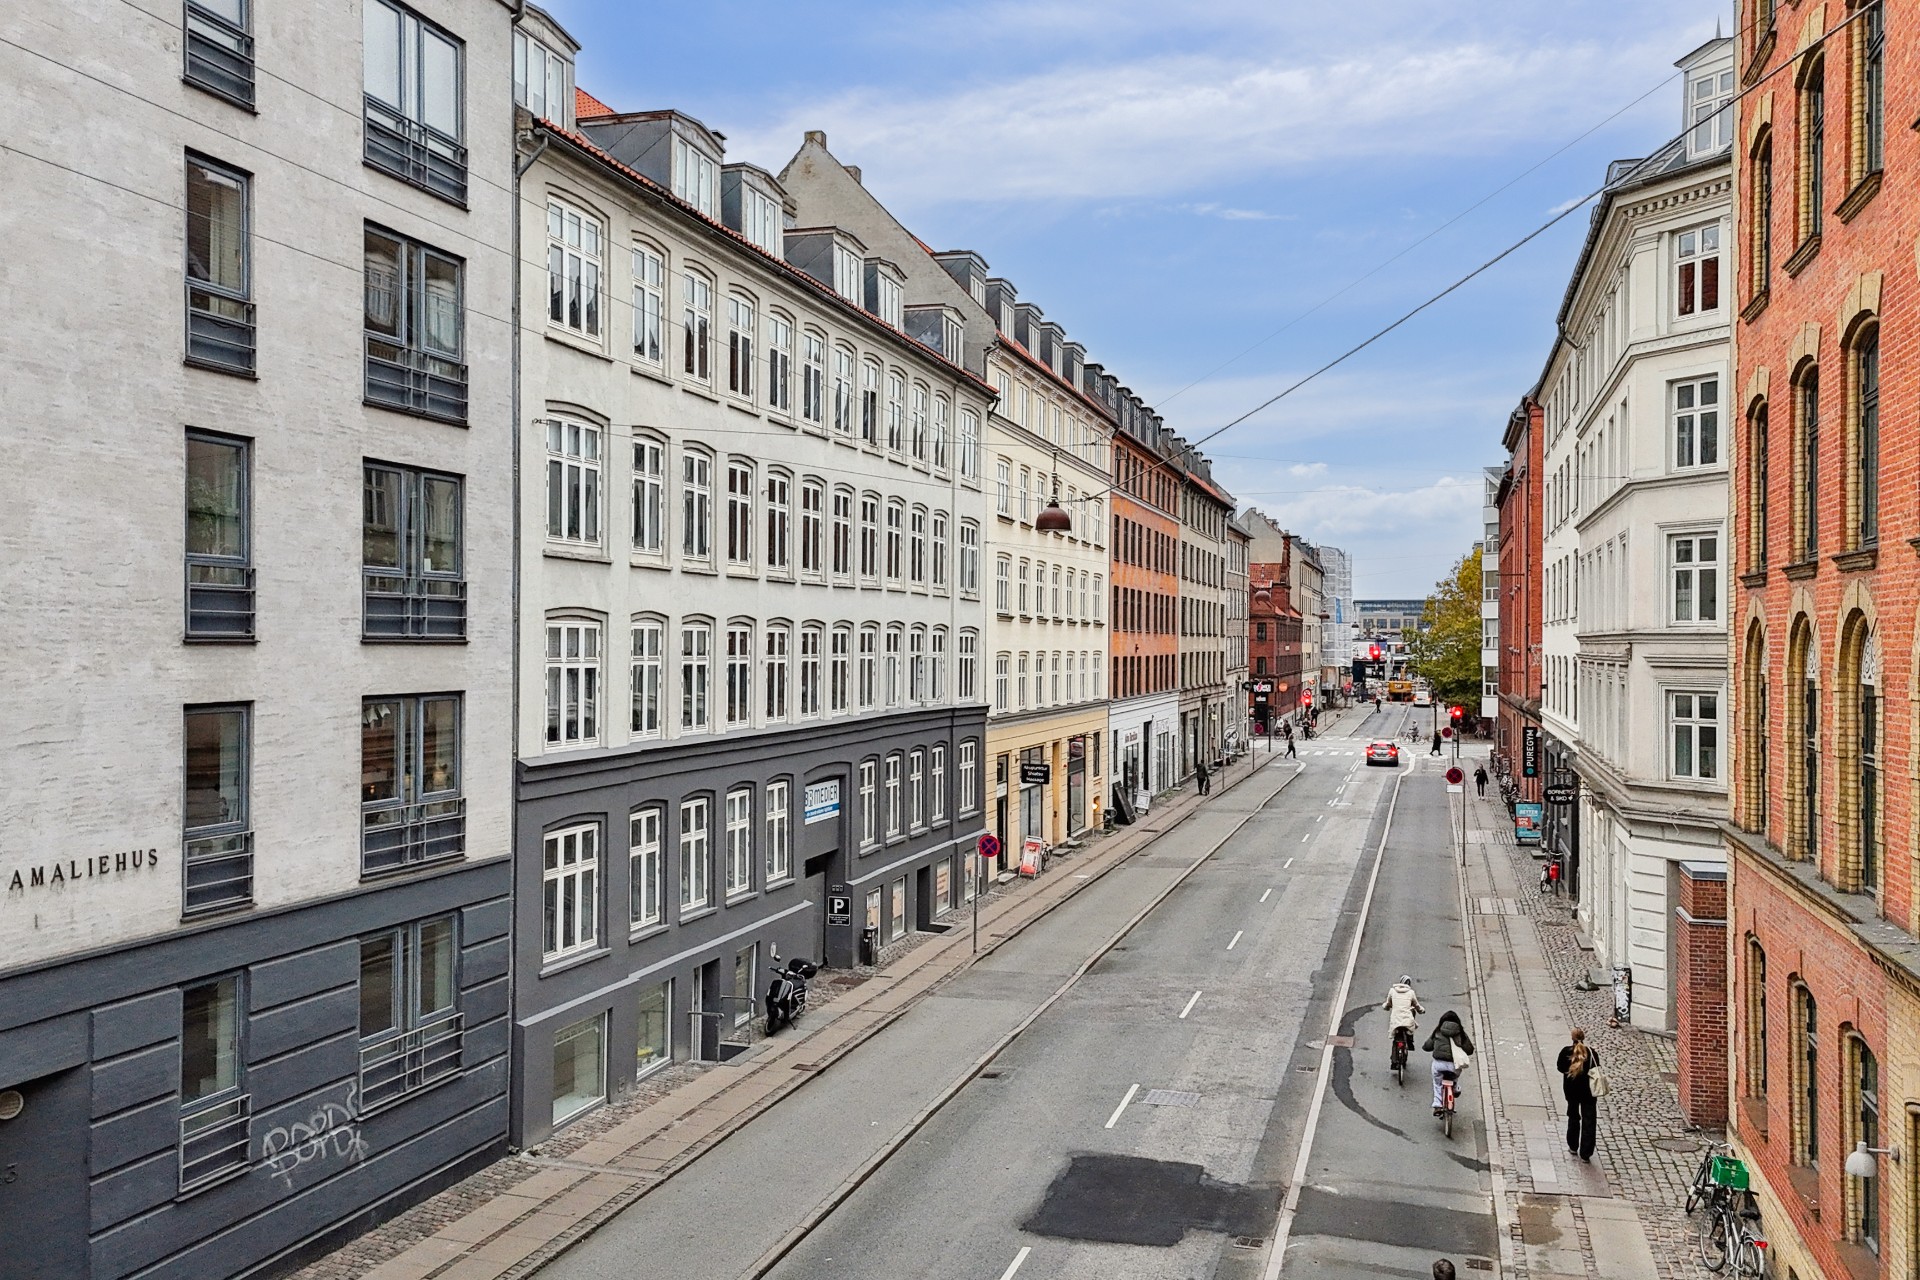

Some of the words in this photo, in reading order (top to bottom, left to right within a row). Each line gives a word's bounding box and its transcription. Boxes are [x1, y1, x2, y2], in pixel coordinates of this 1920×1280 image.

[1526, 729, 1534, 767] PUREGYM
[9, 849, 158, 890] AMALIEHUS
[833, 898, 845, 914] P
